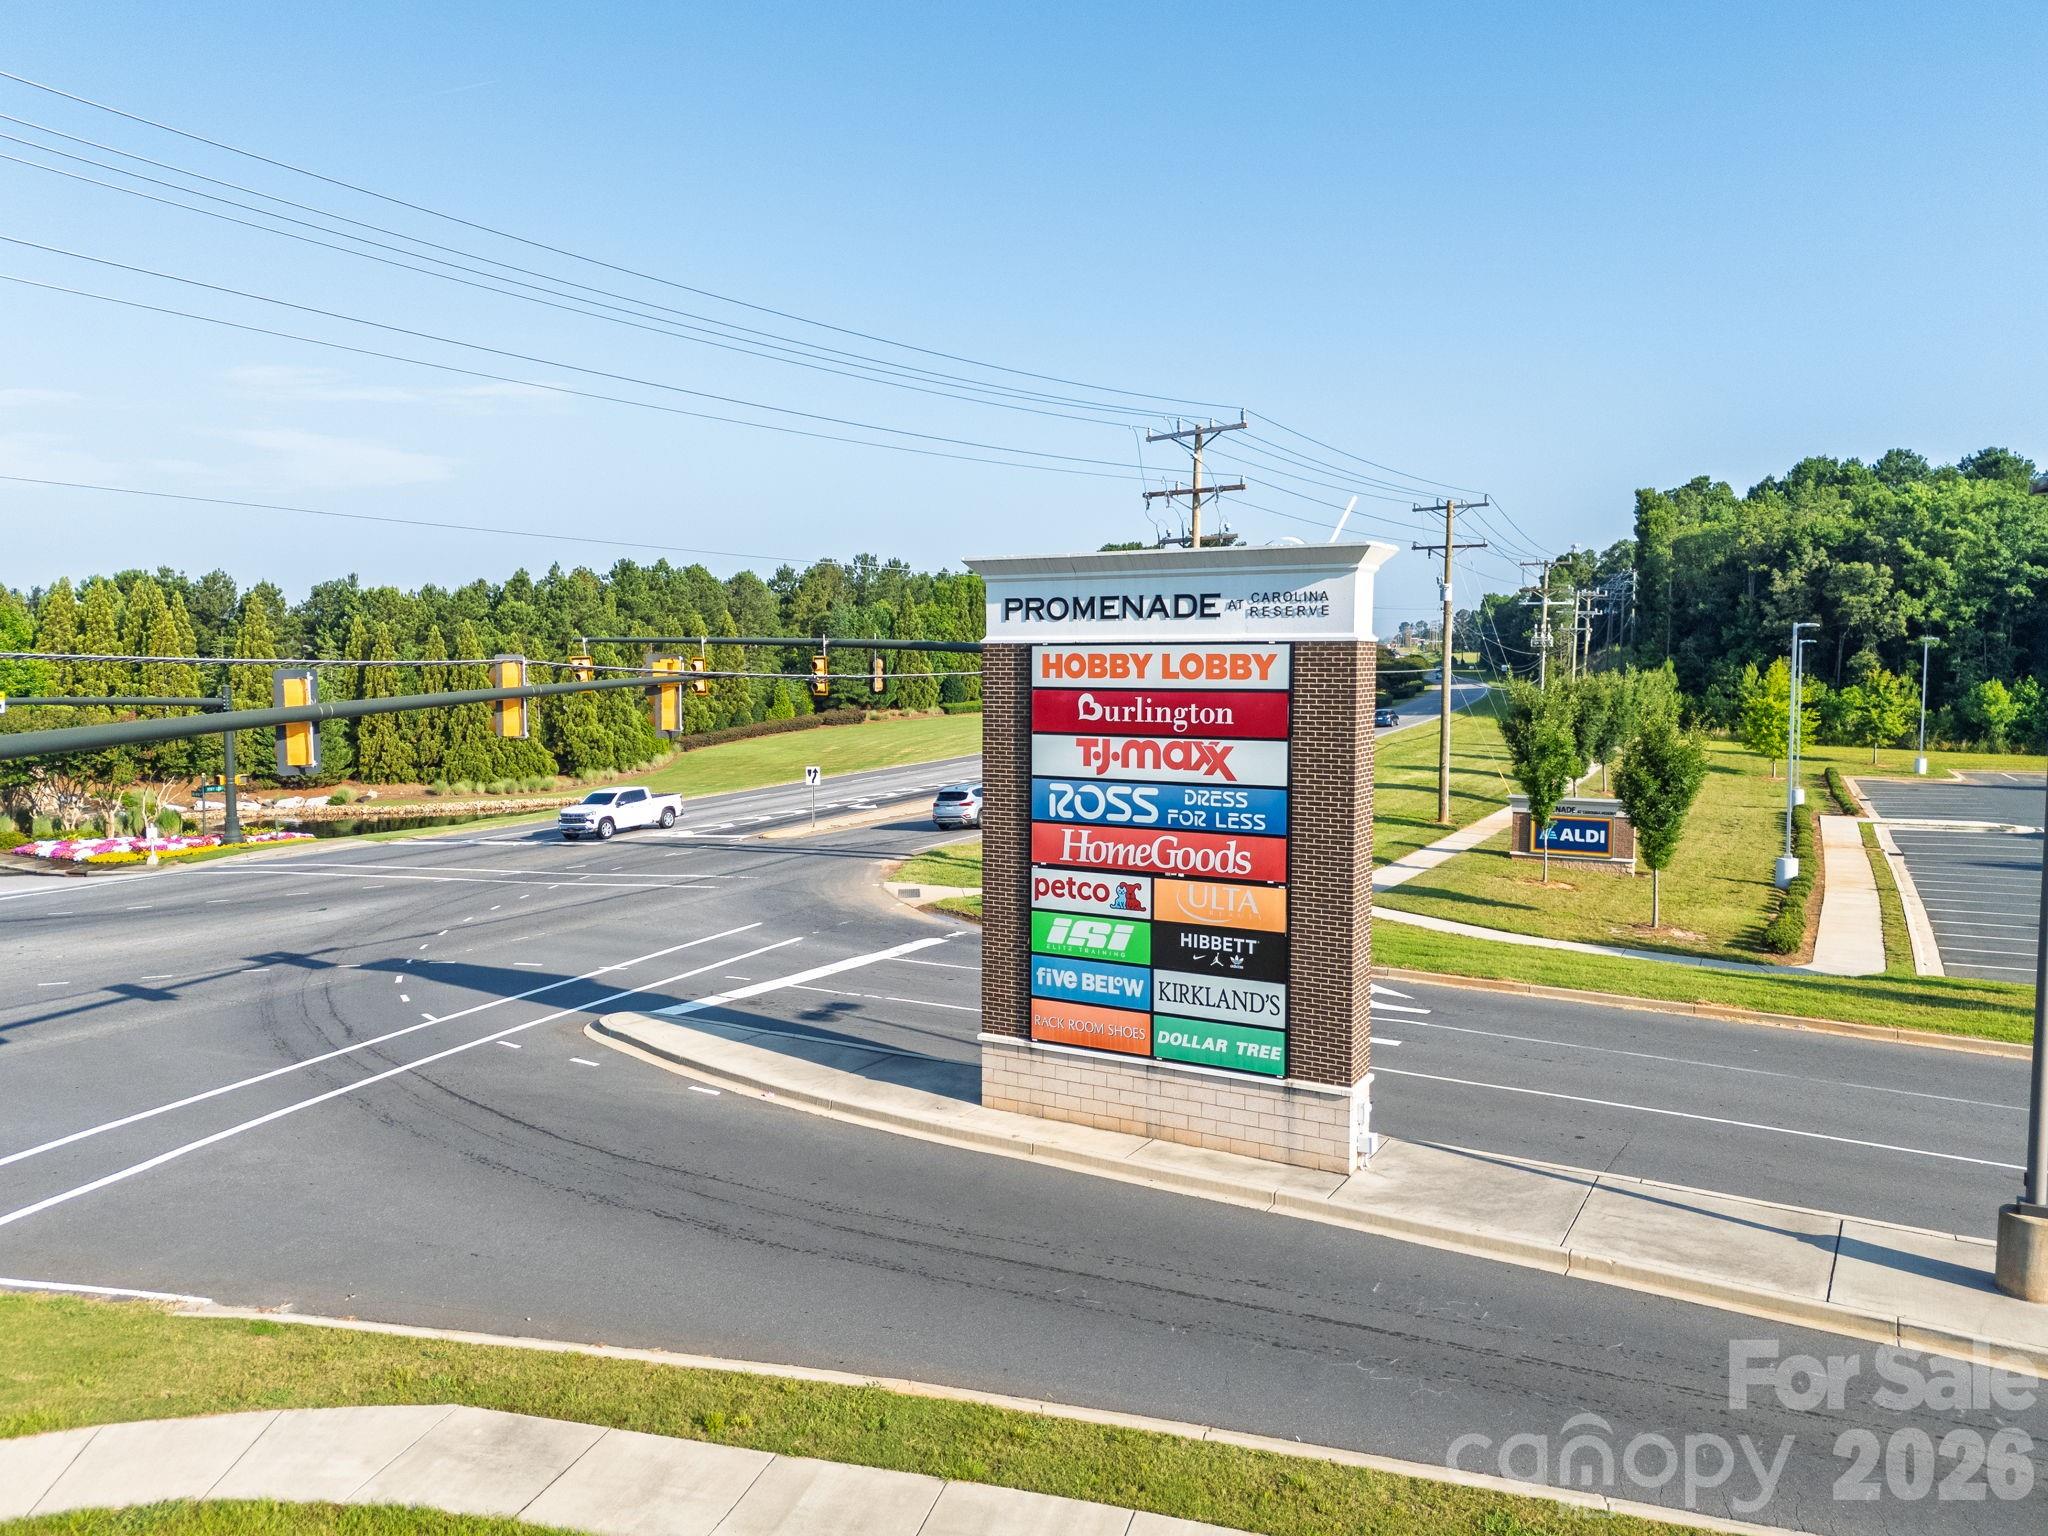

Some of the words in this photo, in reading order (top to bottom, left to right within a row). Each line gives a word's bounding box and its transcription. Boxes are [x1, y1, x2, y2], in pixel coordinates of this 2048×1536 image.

[1004, 592, 1221, 622] PROMENADE
[1228, 599, 1243, 609] AT
[1251, 590, 1329, 603] CAROLINA
[1249, 604, 1329, 617] RESERVE
[1042, 653, 1152, 680] HOBBY
[1161, 653, 1277, 680] LOBBY
[1078, 693, 1234, 732] Burlington
[1049, 783, 1159, 824] ROSS
[1184, 789, 1248, 809] DRESS
[1167, 809, 1206, 828] FOR
[1215, 812, 1266, 831] LESS
[1560, 828, 1606, 844] ALDI
[1059, 828, 1252, 875] HomeGoods
[1034, 877, 1110, 901] petco
[1187, 884, 1259, 914] ULTA
[1079, 947, 1126, 958] TRAINING
[1180, 932, 1257, 955] HIBBETT
[1081, 972, 1144, 998] BELOW
[1158, 981, 1280, 1016] KIRKLAND'S
[1034, 1014, 1065, 1029] RACK
[1068, 1018, 1105, 1035] ROOM
[1108, 1025, 1146, 1040] SHOES
[1157, 1030, 1229, 1053] DOLLAR
[1236, 1041, 1283, 1061] TREE
